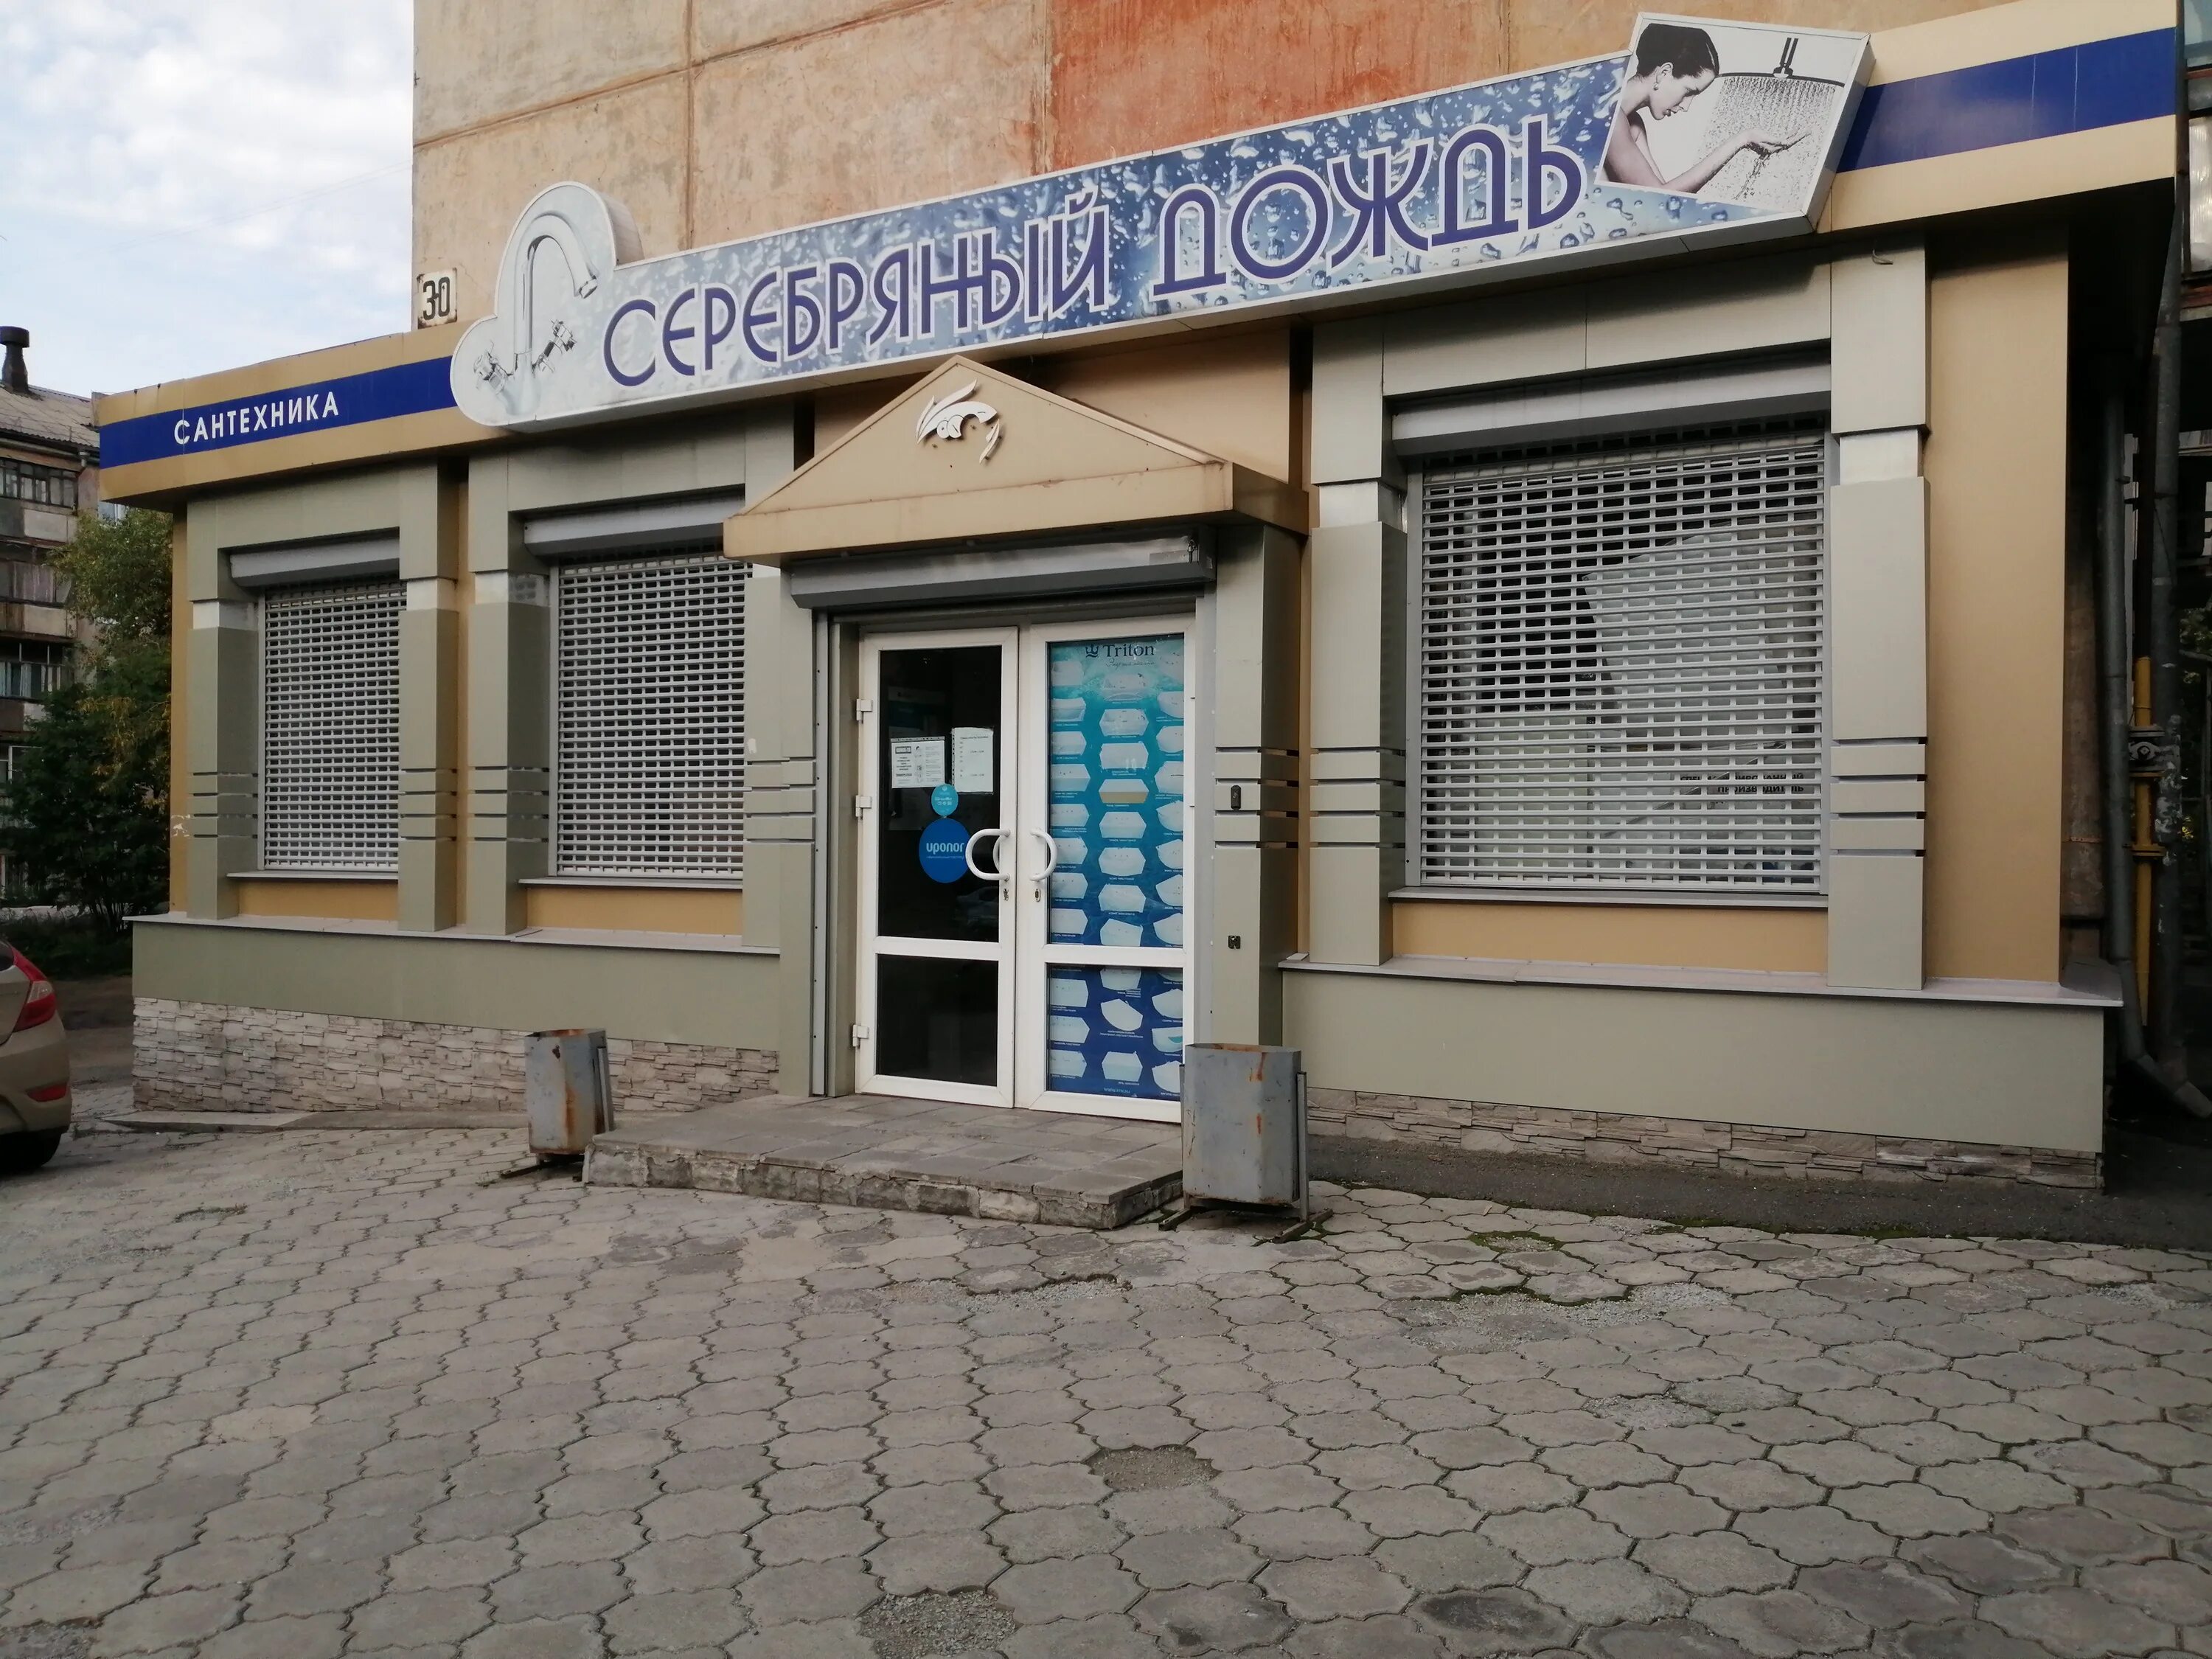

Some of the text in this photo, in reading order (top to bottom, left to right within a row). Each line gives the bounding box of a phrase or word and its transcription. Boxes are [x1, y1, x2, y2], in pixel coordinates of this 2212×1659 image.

[603, 119, 1583, 388] СЕРЕБРЯНЫЙ ДОЖДЬ
[422, 276, 451, 321] 30
[173, 391, 340, 445] САНТЕХНИКА
[1102, 643, 1155, 658] Triton
[1717, 785, 1804, 794] ПРИЗВДИТЛЬ
[925, 842, 965, 855] uponor
